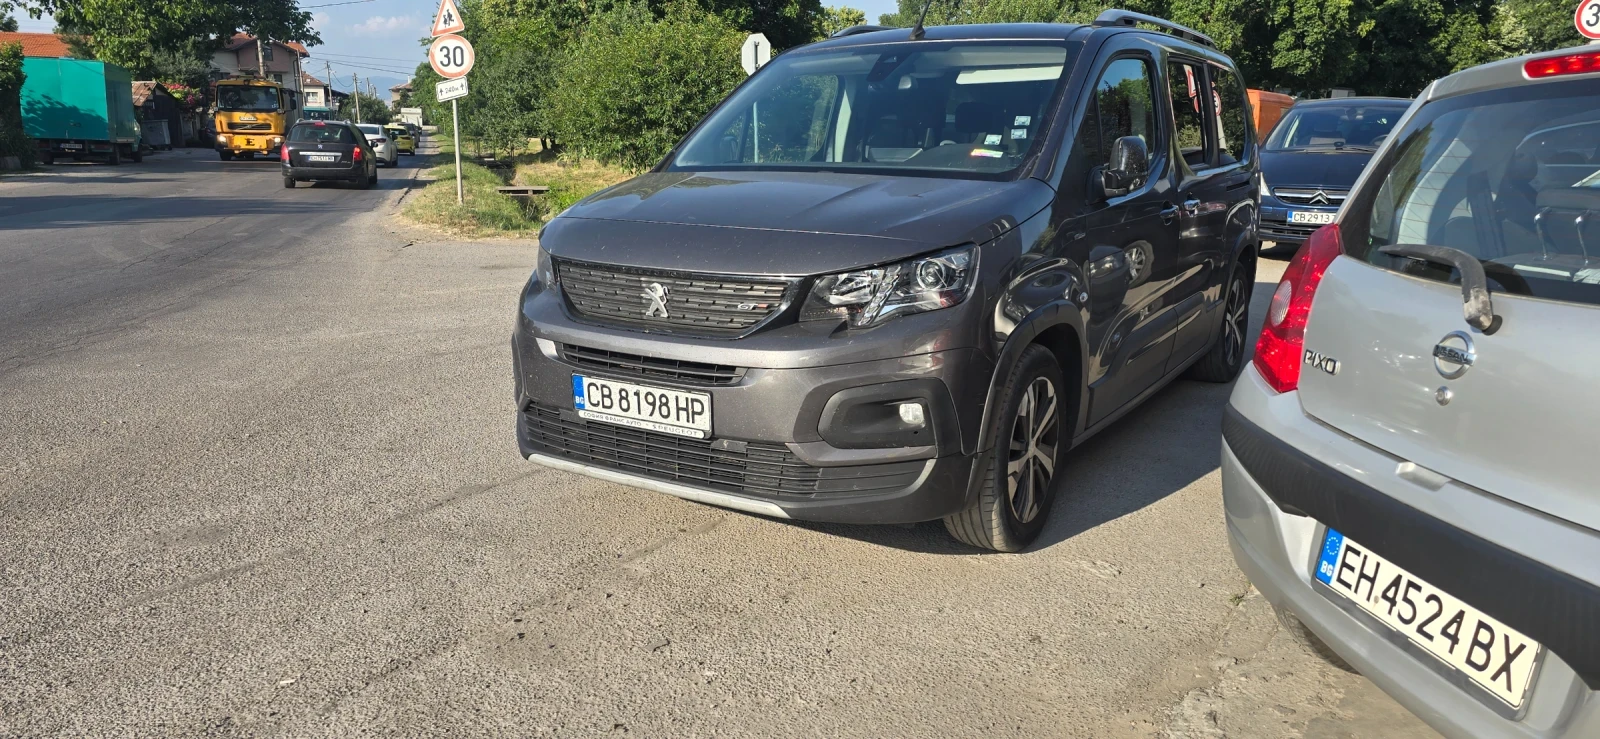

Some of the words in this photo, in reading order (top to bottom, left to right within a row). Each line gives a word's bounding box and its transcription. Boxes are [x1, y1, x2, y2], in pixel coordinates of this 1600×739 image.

[1586, 3, 1600, 27] 3
[440, 46, 464, 67] 30
[1294, 213, 1306, 222] CB
[1307, 214, 1330, 223] 2913
[738, 303, 758, 311] GT
[1303, 349, 1341, 376] PIXO
[1433, 345, 1469, 363] NISSAN
[575, 395, 585, 404] BG
[587, 382, 613, 409] CB
[618, 388, 671, 419] 8198
[675, 395, 705, 424] HP
[658, 425, 698, 436] PEUGEOT
[1320, 560, 1334, 577] BG
[1336, 544, 1381, 602] EH
[1381, 574, 1466, 655] 4524
[1465, 619, 1527, 693] BX
